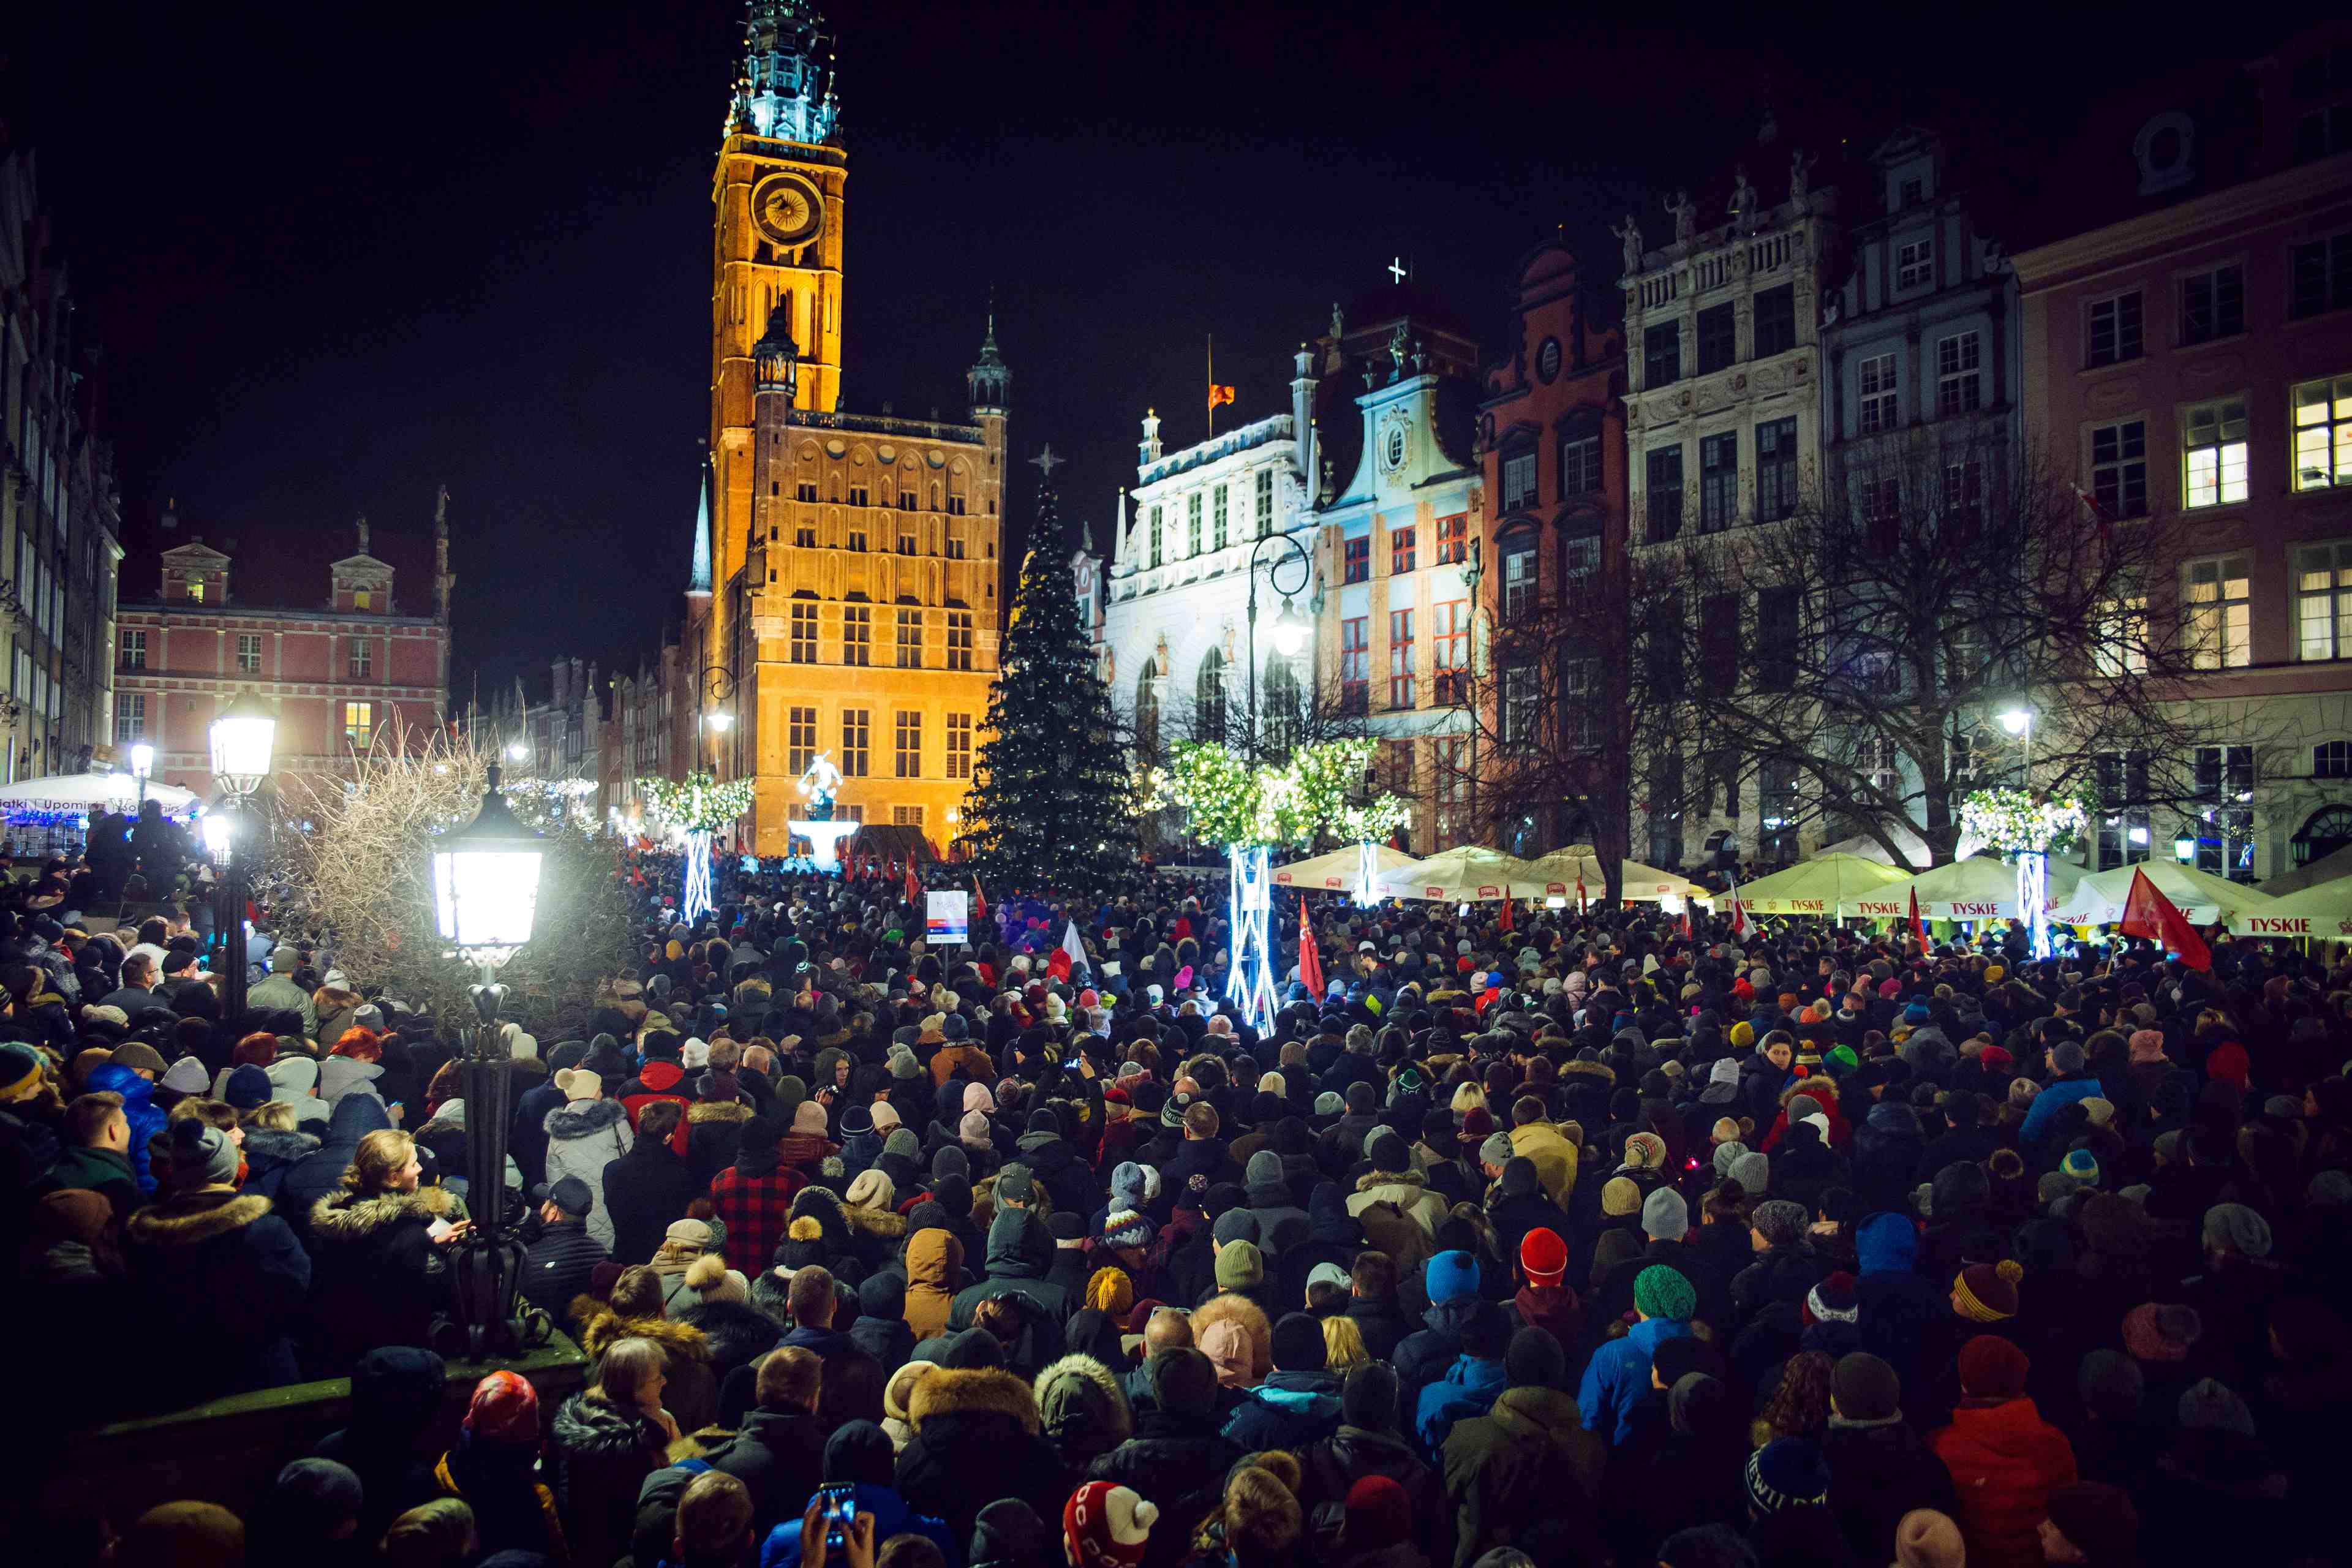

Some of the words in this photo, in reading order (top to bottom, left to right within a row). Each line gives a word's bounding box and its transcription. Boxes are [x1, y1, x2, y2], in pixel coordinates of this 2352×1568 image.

[1791, 900, 1824, 910] TYSKIE
[1858, 902, 1901, 914] TYSKIE
[1950, 903, 1999, 915] TYSKIE
[2248, 918, 2312, 932] TYSKIE
